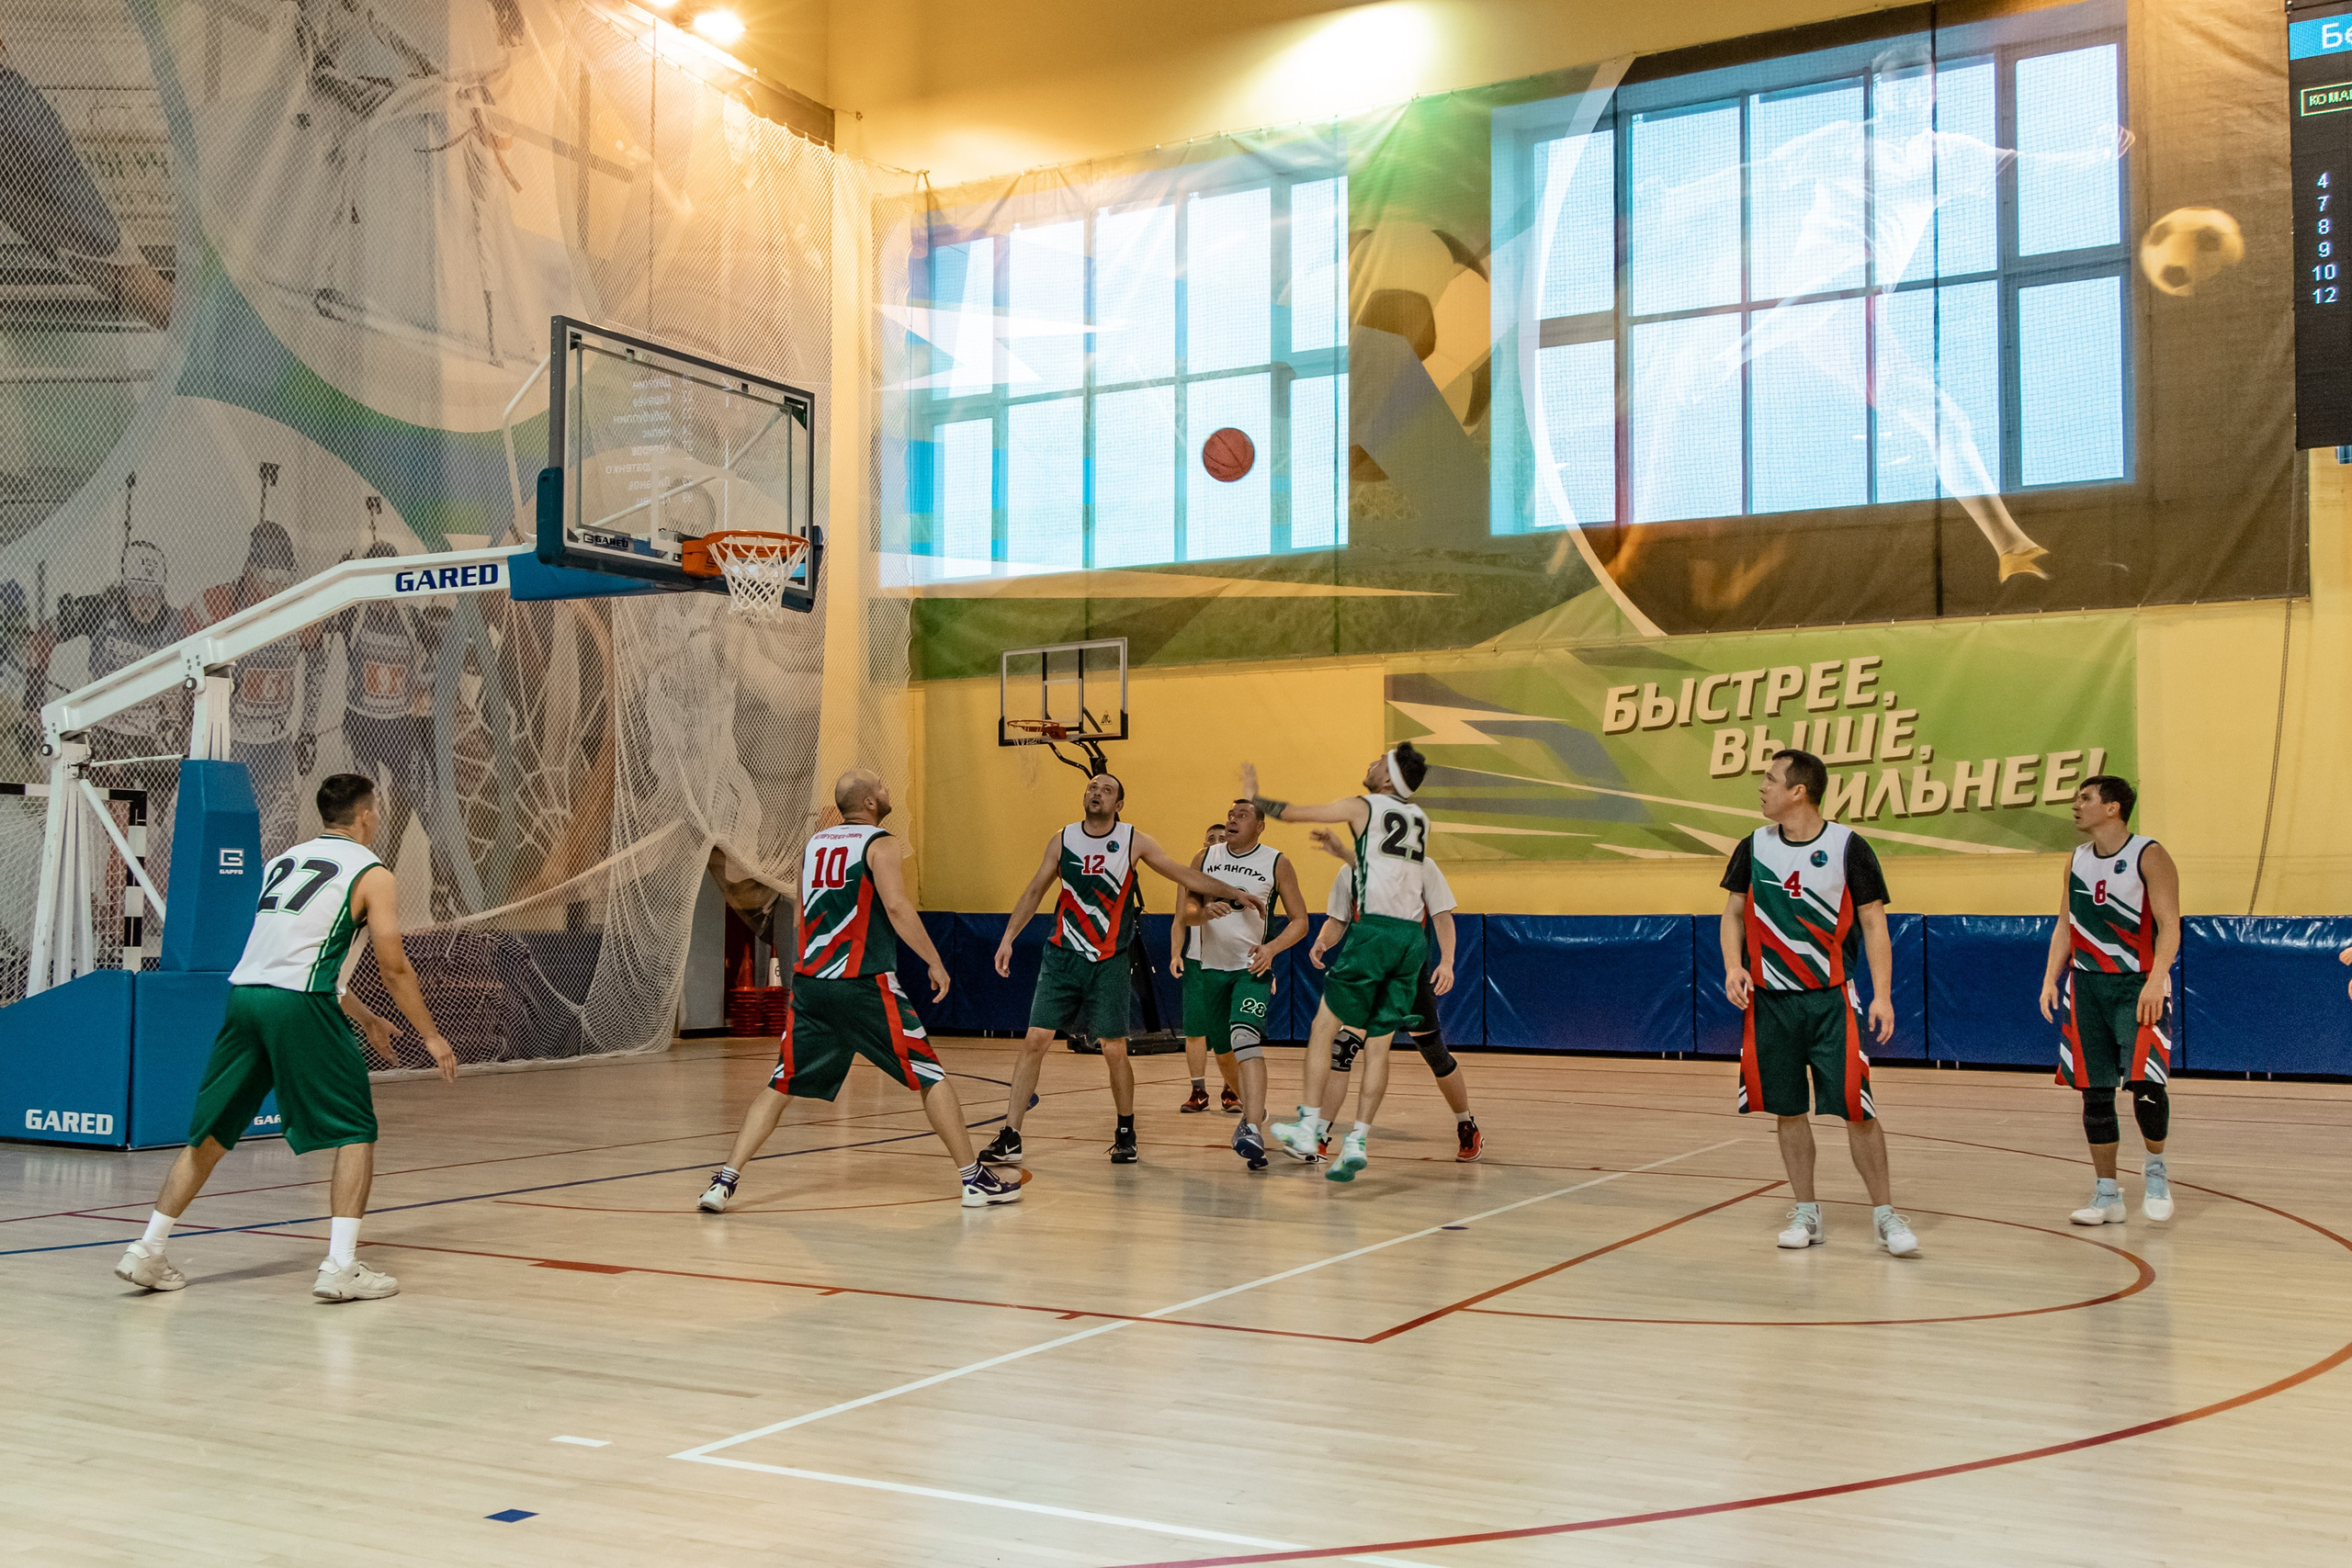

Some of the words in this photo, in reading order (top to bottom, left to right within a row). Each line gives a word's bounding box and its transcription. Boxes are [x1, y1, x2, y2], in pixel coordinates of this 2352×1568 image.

[2309, 89, 2352, 107] КОМА
[2316, 172, 2330, 189] 4
[2317, 194, 2331, 212] 7
[2317, 218, 2332, 234] 8
[2318, 240, 2332, 258] 9
[2312, 263, 2337, 281] 10
[2312, 287, 2337, 304] 12
[595, 535, 628, 548] GARED
[395, 563, 499, 592] GARED
[1602, 655, 1898, 735] БЫСТРЕЕ,
[1709, 708, 1935, 779] ВЫШЕ,
[1823, 747, 2107, 820] ИЛЬНЕЕ!
[1379, 809, 1426, 864] 23
[811, 846, 849, 888] 10
[1082, 854, 1105, 874] 12
[1224, 863, 1267, 882] ЯНГПУР
[256, 856, 342, 916] 27
[1783, 870, 1802, 897] 4
[2094, 879, 2107, 904] 8
[1239, 997, 1267, 1018] 28
[25, 1109, 114, 1135] GARED
[254, 1113, 281, 1126] GAR
